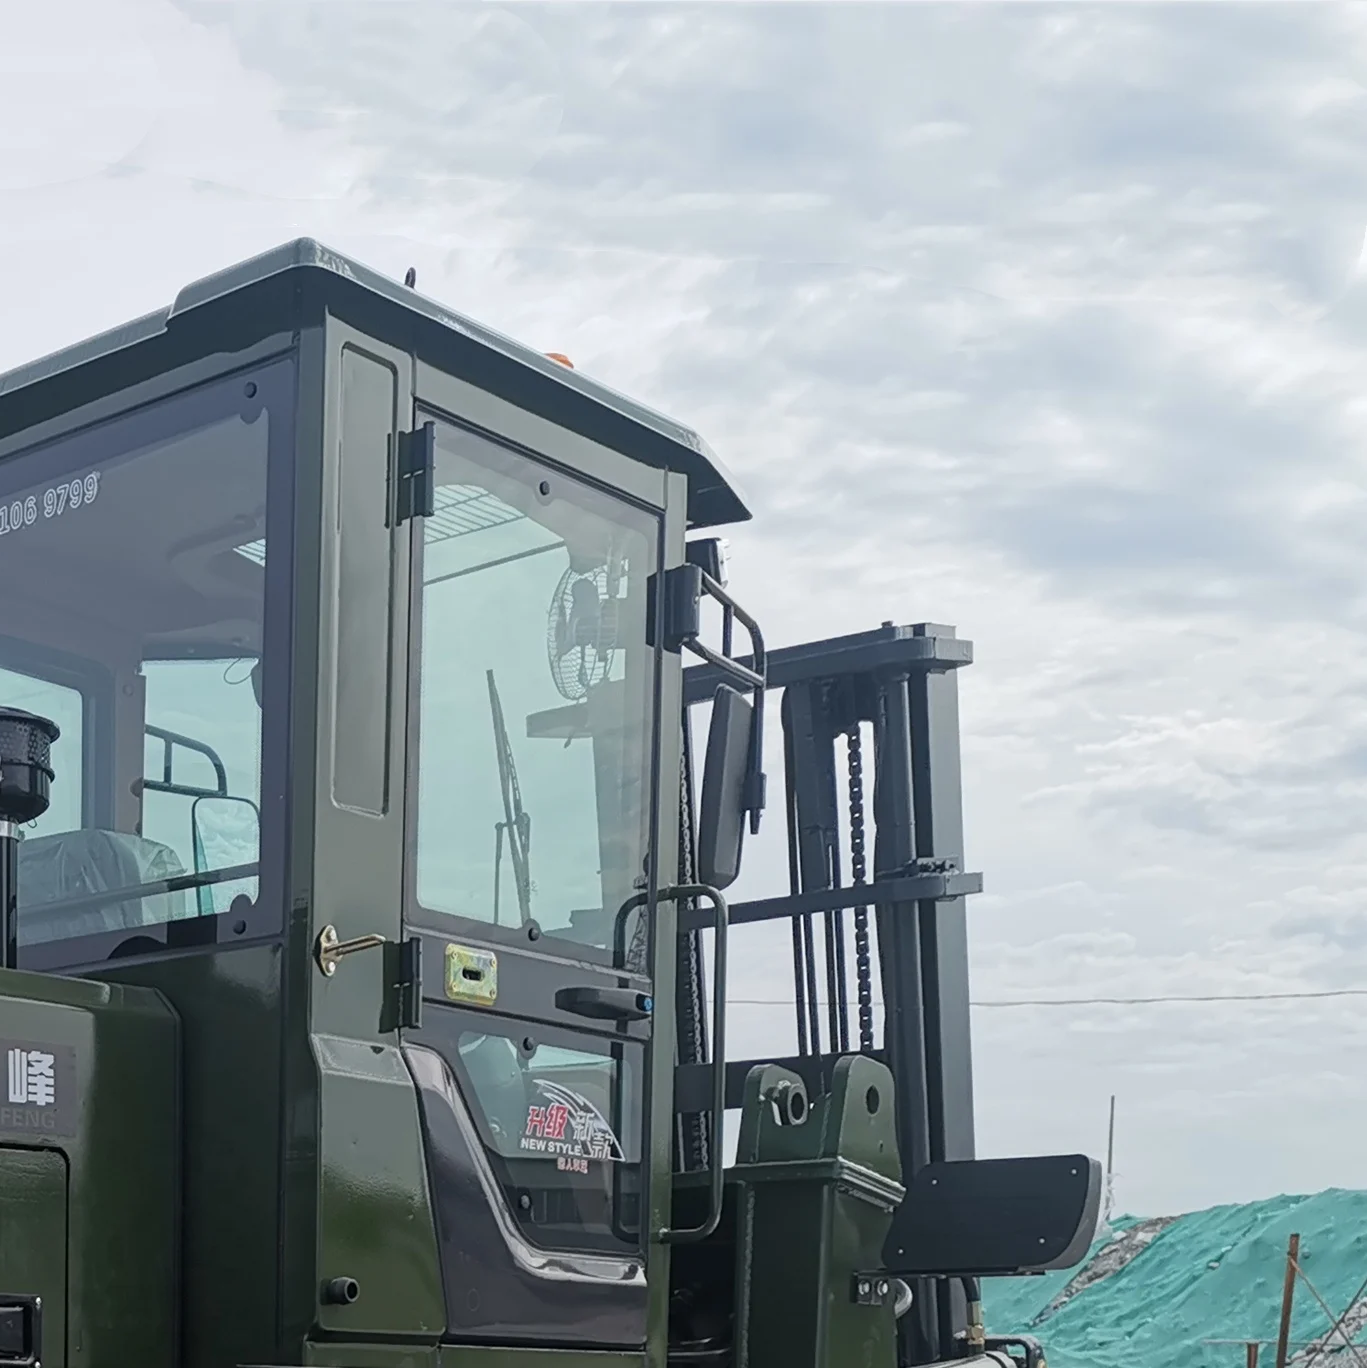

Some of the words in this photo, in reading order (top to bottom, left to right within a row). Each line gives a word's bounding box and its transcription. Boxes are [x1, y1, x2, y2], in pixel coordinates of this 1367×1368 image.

[43, 472, 99, 518] 9799
[0, 1108, 56, 1129] FENG
[525, 1102, 569, 1140] 升级
[520, 1137, 547, 1152] NEW
[547, 1141, 581, 1157] STYLE
